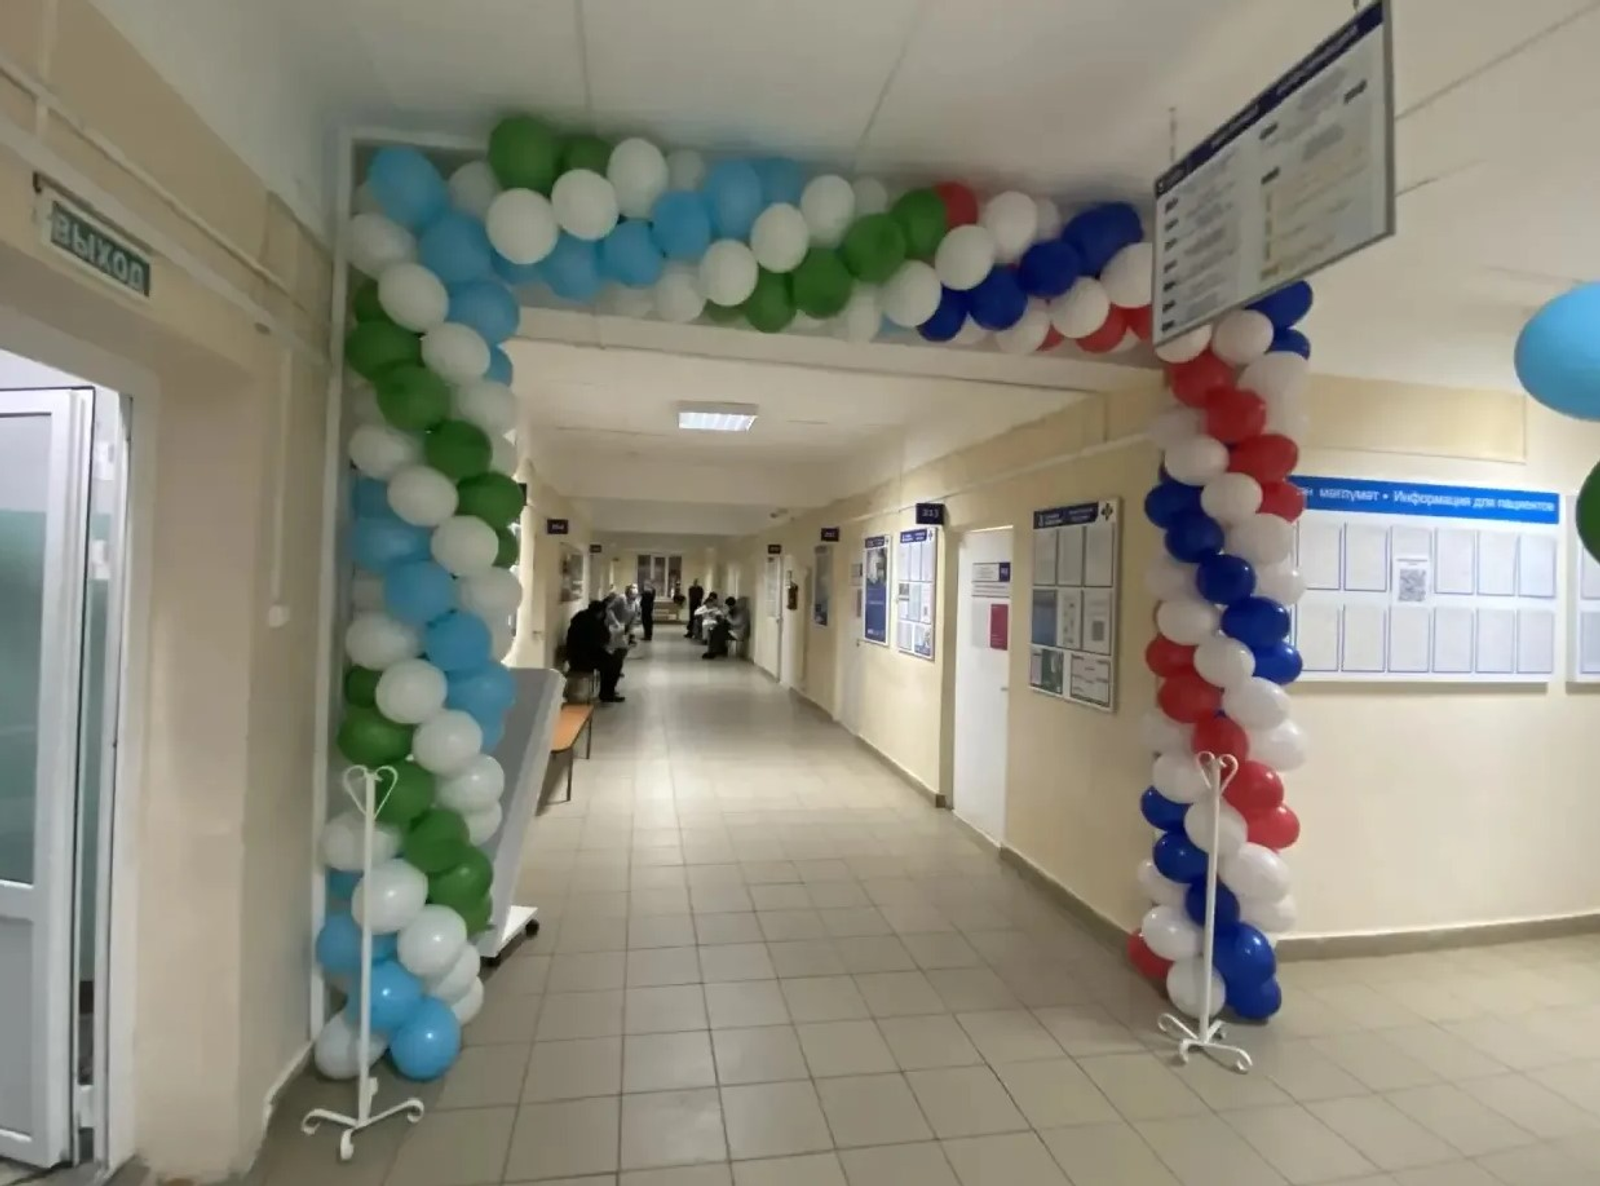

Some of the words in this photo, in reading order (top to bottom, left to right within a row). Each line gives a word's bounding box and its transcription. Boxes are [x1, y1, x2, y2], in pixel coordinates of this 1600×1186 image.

[54, 212, 145, 293] ВЫХОД
[1393, 489, 1470, 507] Информация
[1472, 497, 1495, 509] для
